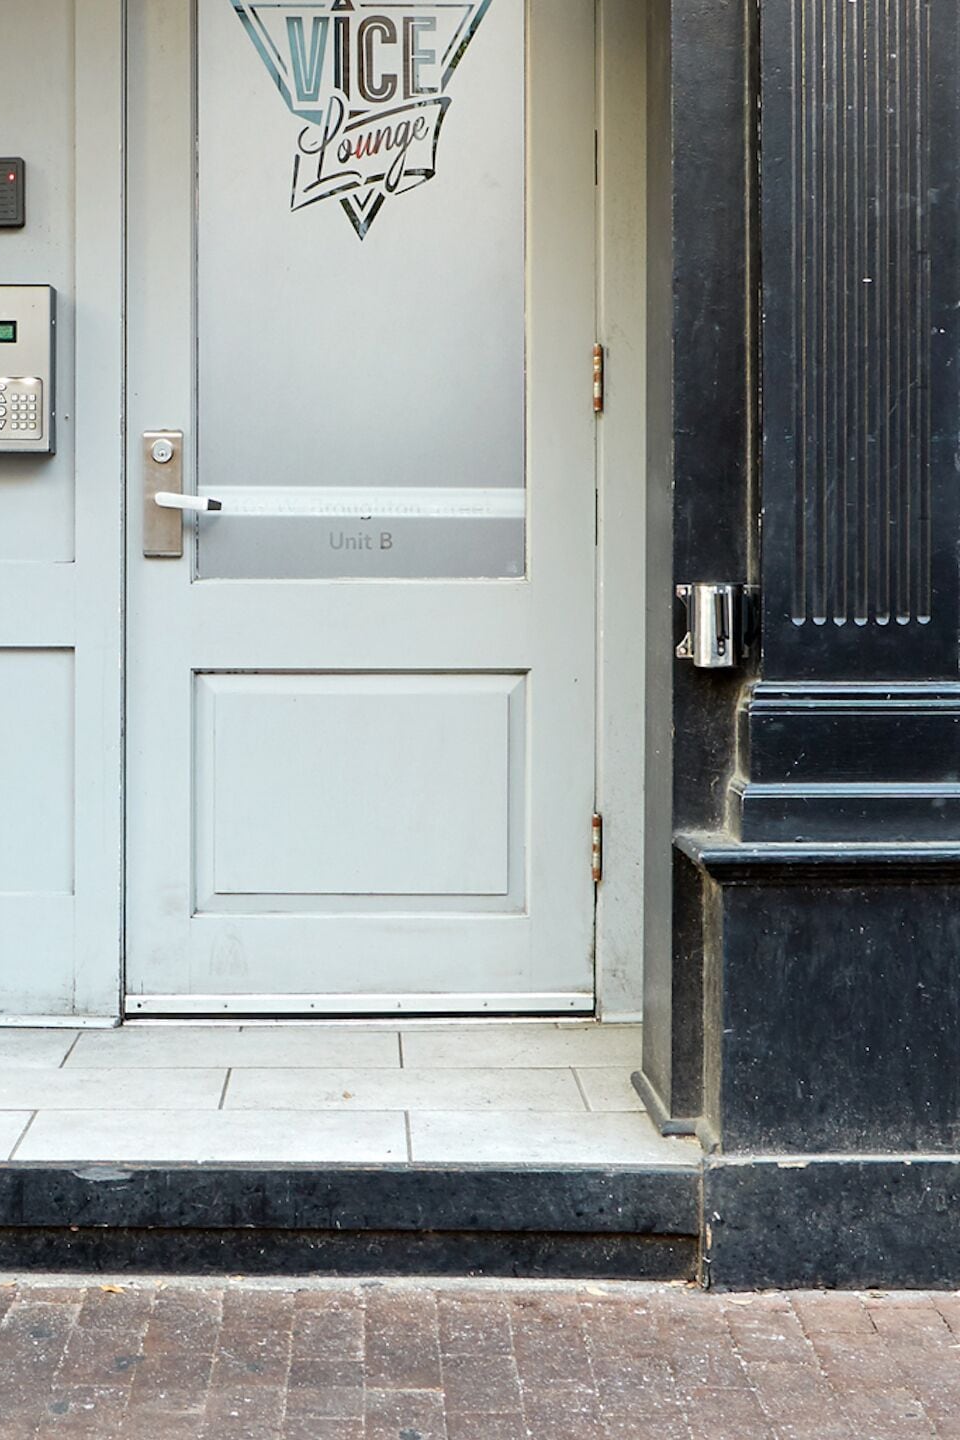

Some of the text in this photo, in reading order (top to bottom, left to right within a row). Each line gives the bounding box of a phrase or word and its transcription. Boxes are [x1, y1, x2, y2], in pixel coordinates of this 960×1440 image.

[285, 15, 438, 104] VICE
[297, 96, 430, 193] Lounge
[329, 531, 393, 550] Unit B
